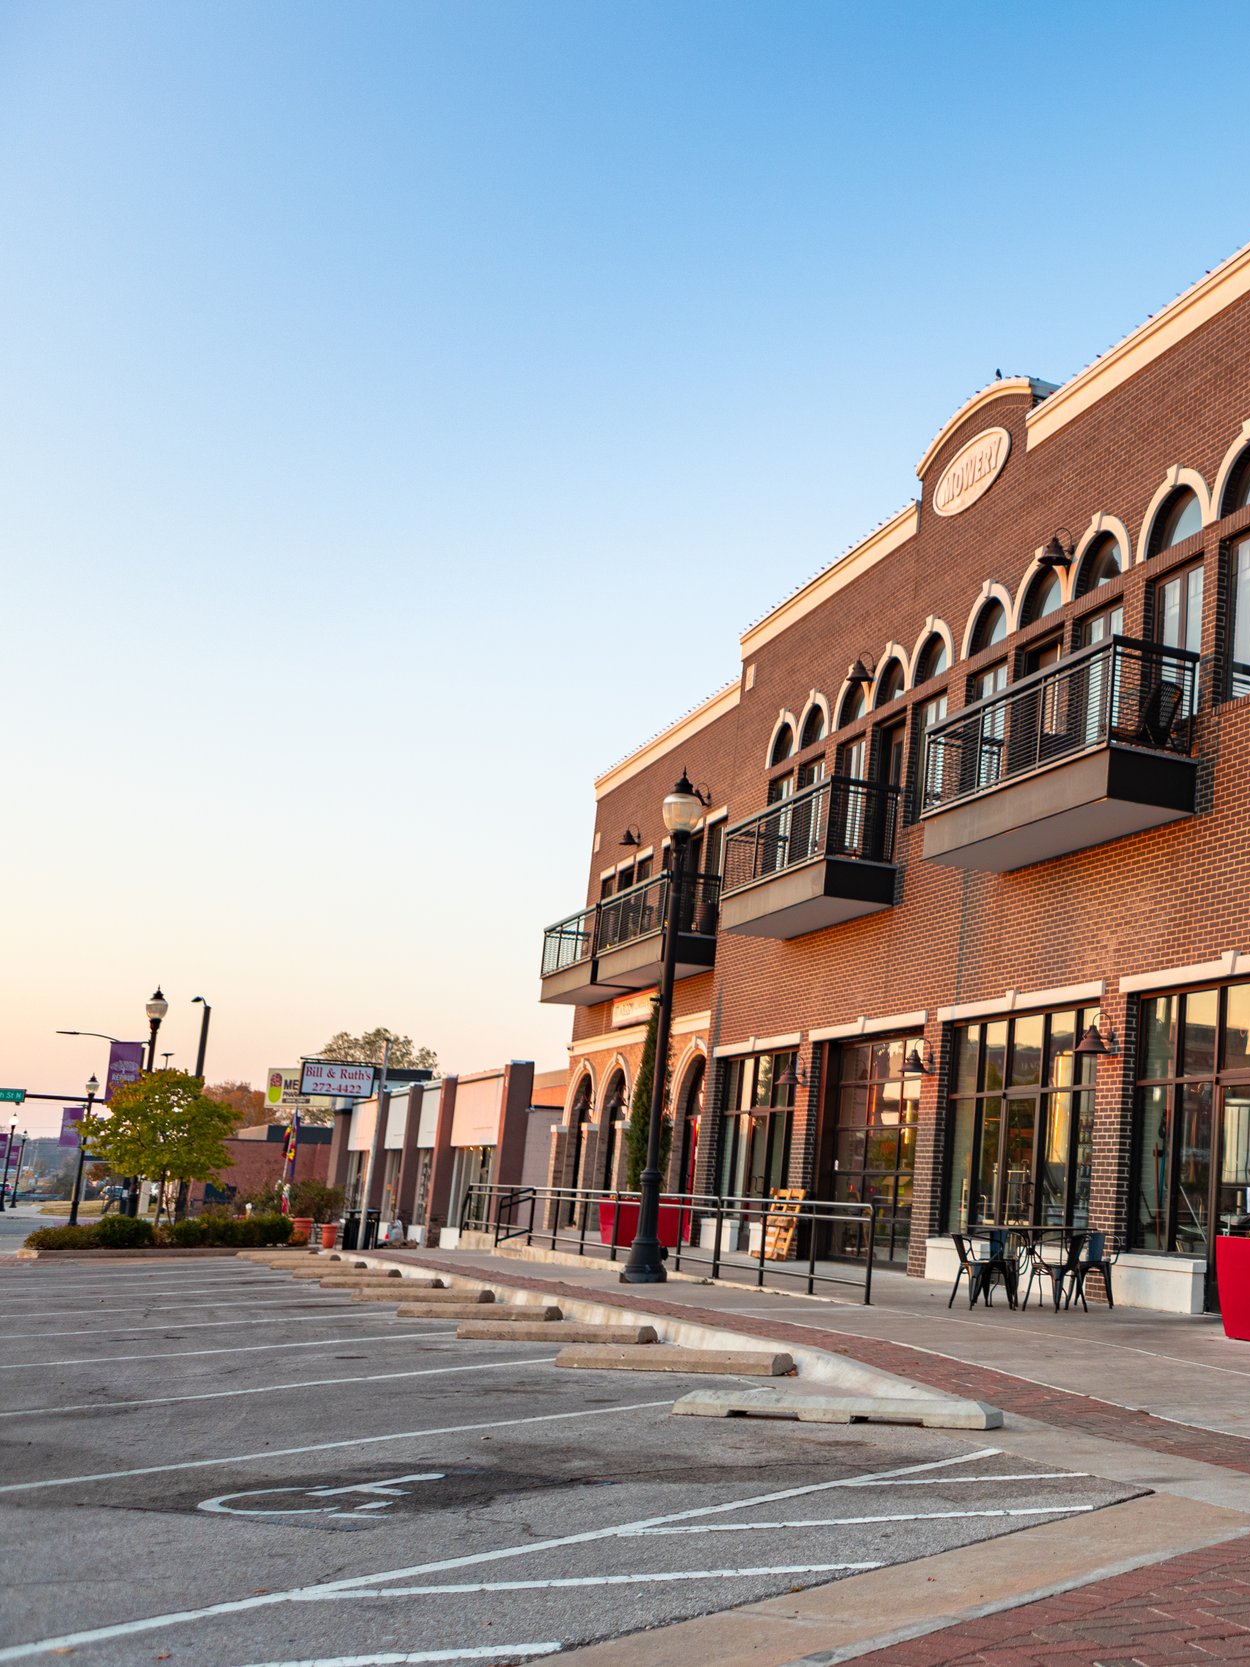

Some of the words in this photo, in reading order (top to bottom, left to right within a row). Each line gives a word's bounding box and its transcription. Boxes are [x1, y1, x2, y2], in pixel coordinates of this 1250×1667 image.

[305, 1066, 323, 1078] Bill
[326, 1067, 336, 1079] &
[340, 1068, 372, 1081] Ruth's
[312, 1082, 362, 1095] 272-4422
[5, 1091, 15, 1099] St
[15, 1092, 22, 1100] N
